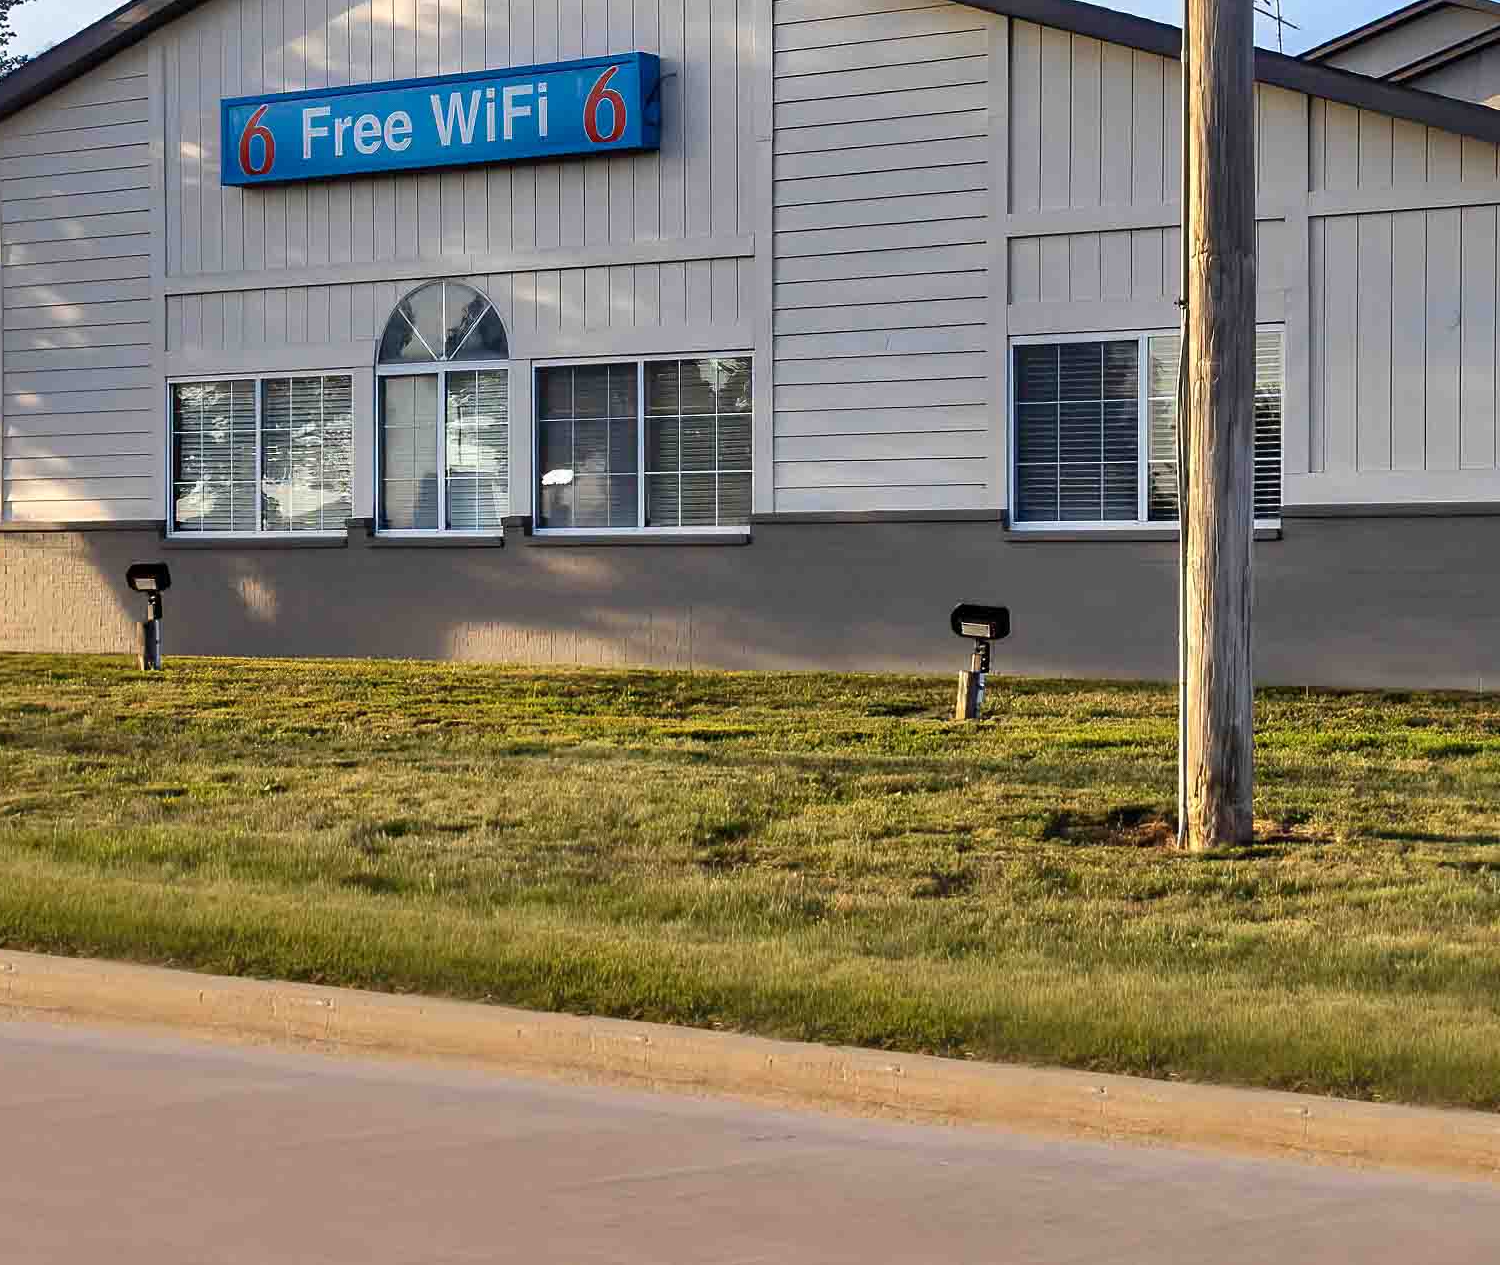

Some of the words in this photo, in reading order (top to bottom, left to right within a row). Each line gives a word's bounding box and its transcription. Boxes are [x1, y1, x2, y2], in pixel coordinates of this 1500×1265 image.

[238, 103, 276, 176] 6
[302, 105, 414, 160] Free
[430, 81, 549, 147] WiFi
[582, 65, 628, 144] 6
